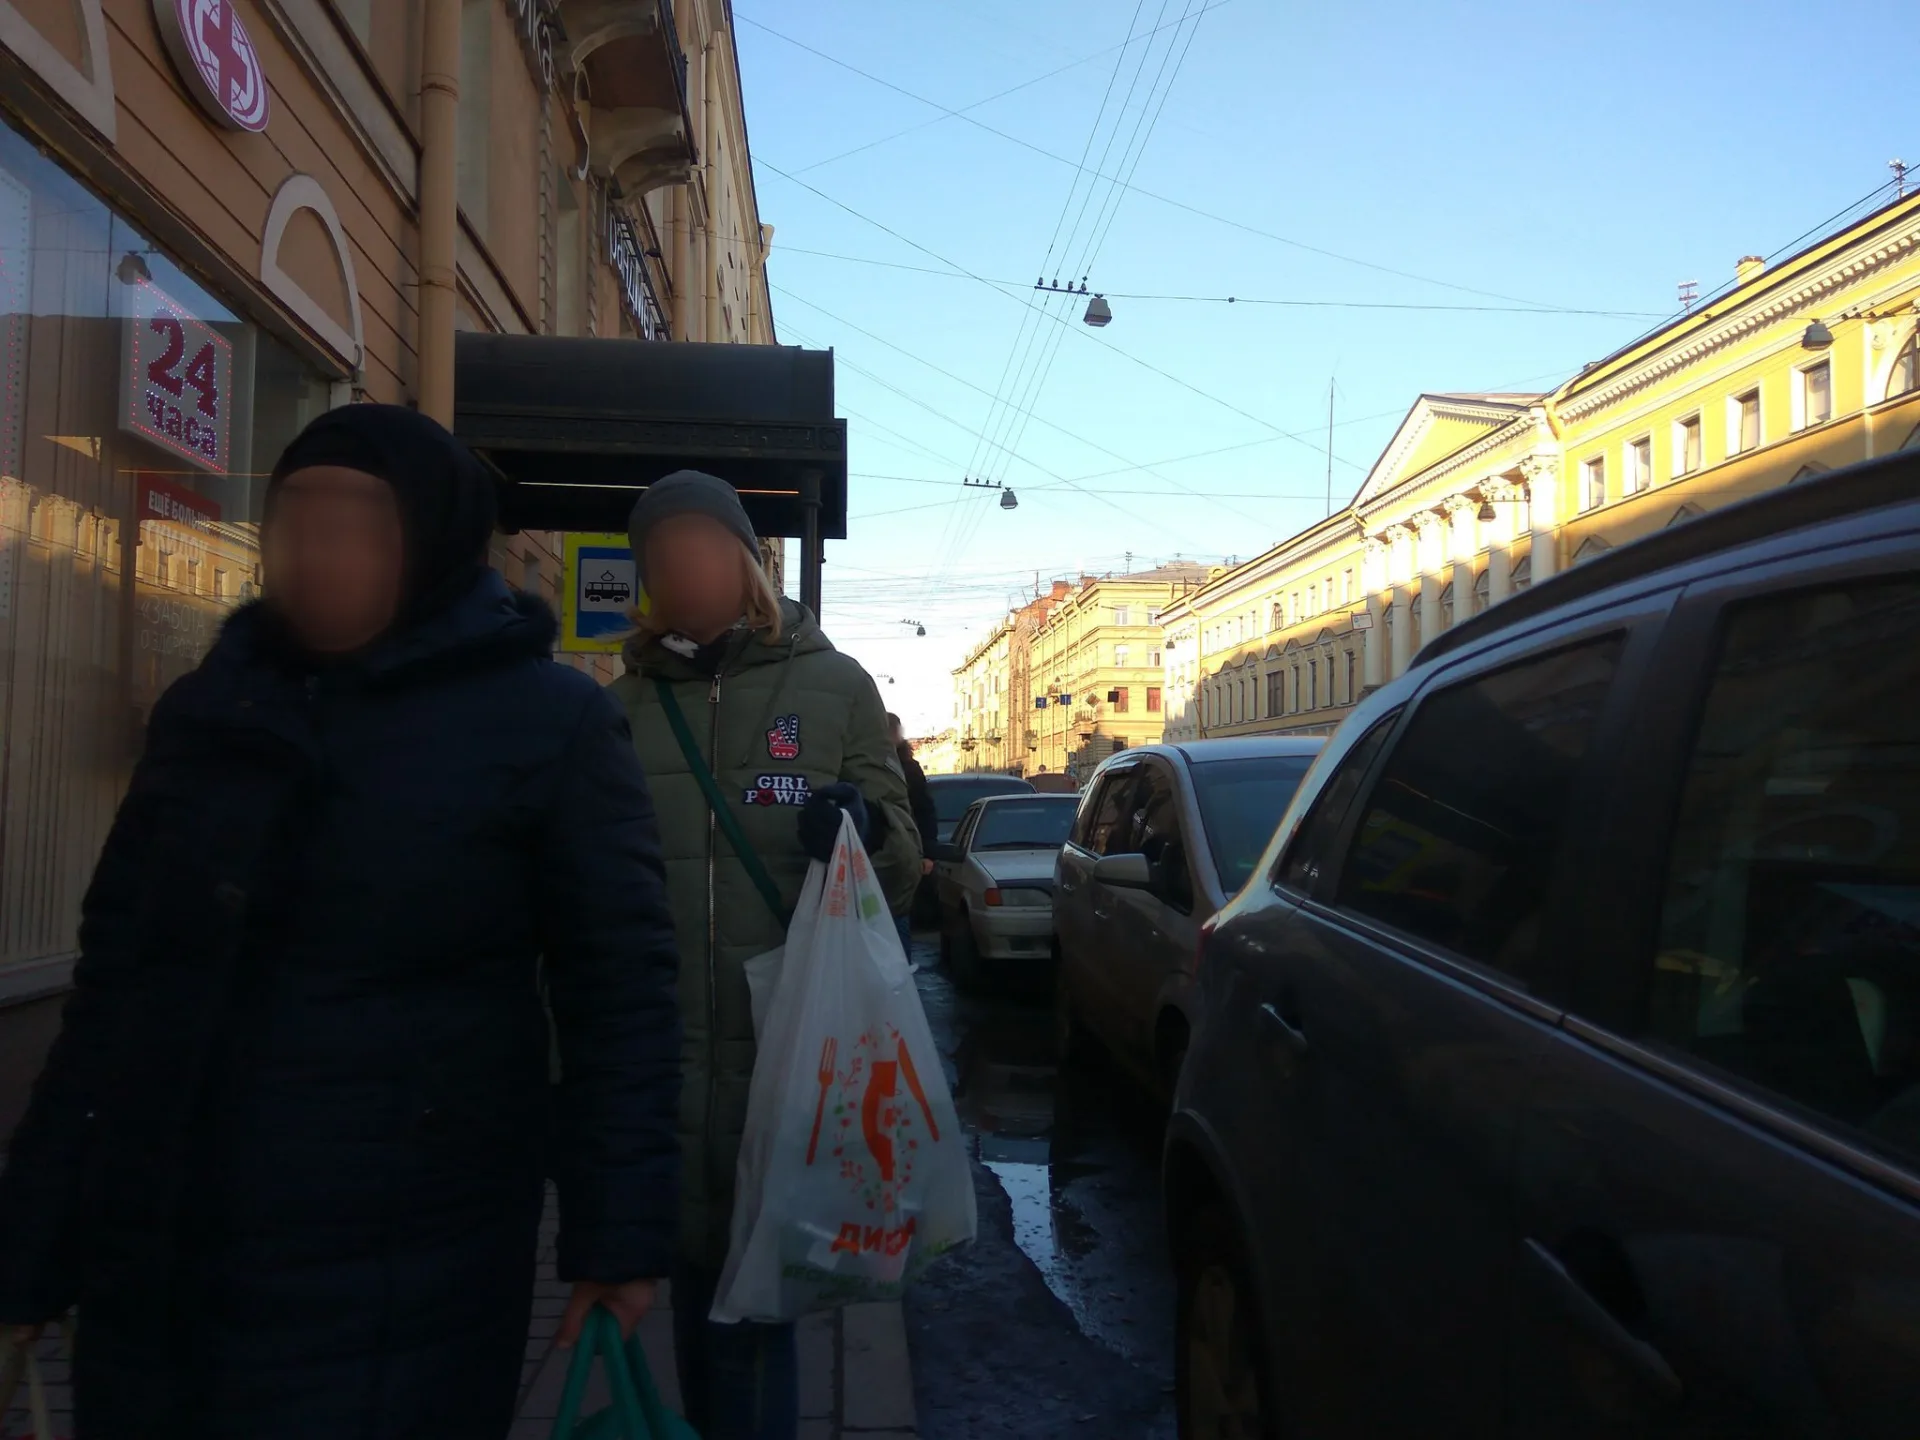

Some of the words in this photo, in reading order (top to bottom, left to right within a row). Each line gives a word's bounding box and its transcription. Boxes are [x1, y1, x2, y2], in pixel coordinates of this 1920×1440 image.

[147, 306, 217, 420] 24
[146, 390, 217, 461] часа
[148, 490, 171, 518] ЕЩЁ
[744, 788, 814, 807] POWE
[756, 775, 809, 792] GIRL
